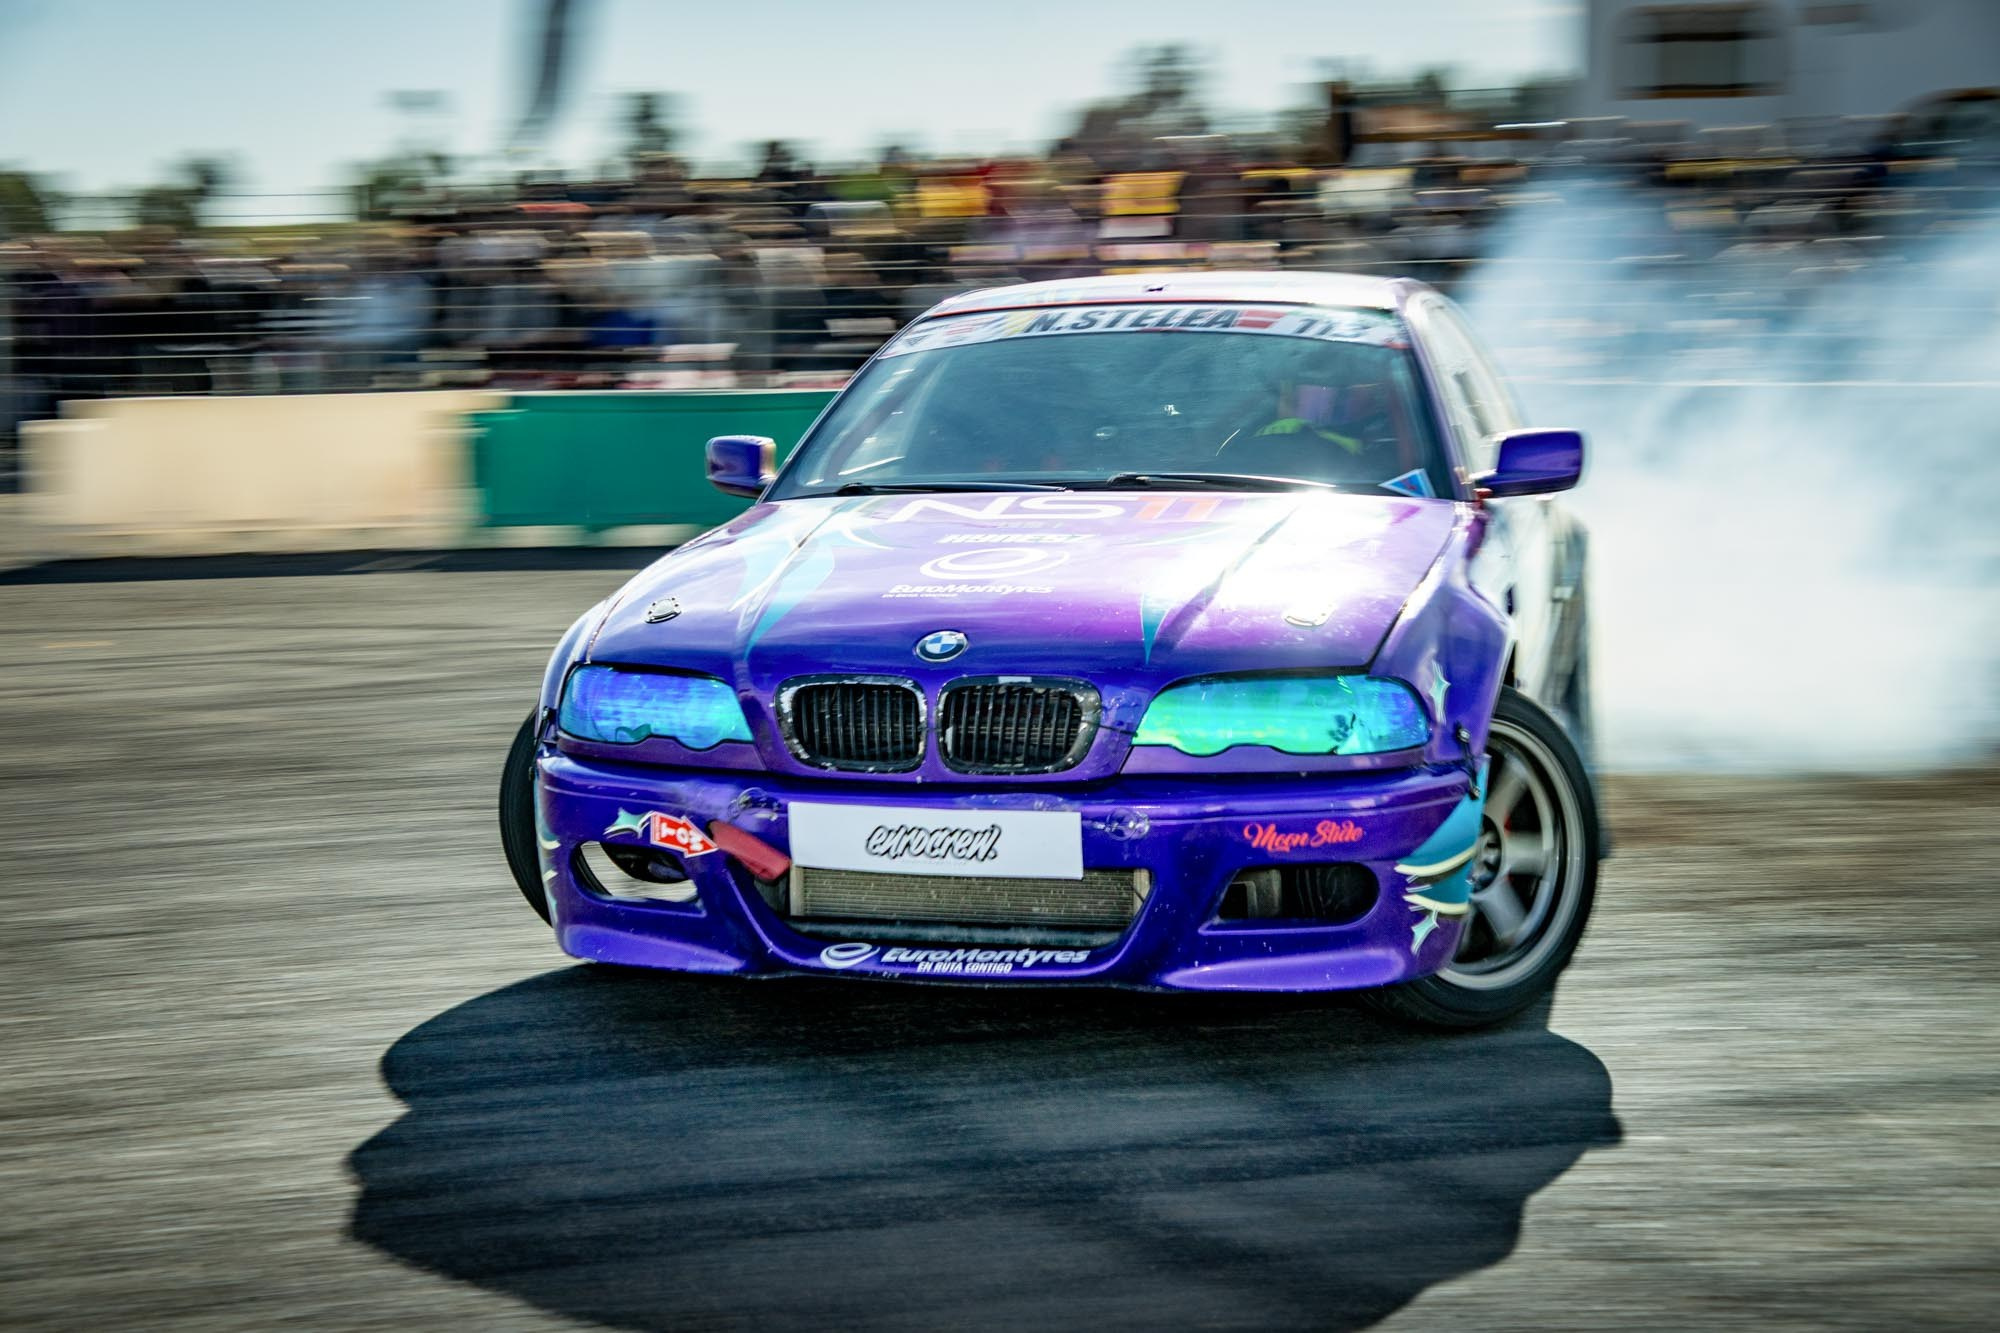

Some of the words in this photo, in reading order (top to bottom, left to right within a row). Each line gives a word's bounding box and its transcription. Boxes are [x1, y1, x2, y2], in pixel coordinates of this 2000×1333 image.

[661, 822, 704, 852] TOW
[1243, 823, 1309, 853] Moon
[881, 948, 1091, 967] EuroMontyres
[917, 961, 933, 972] EN
[933, 961, 963, 973] RUTA
[964, 962, 1013, 974] CONTIGO
